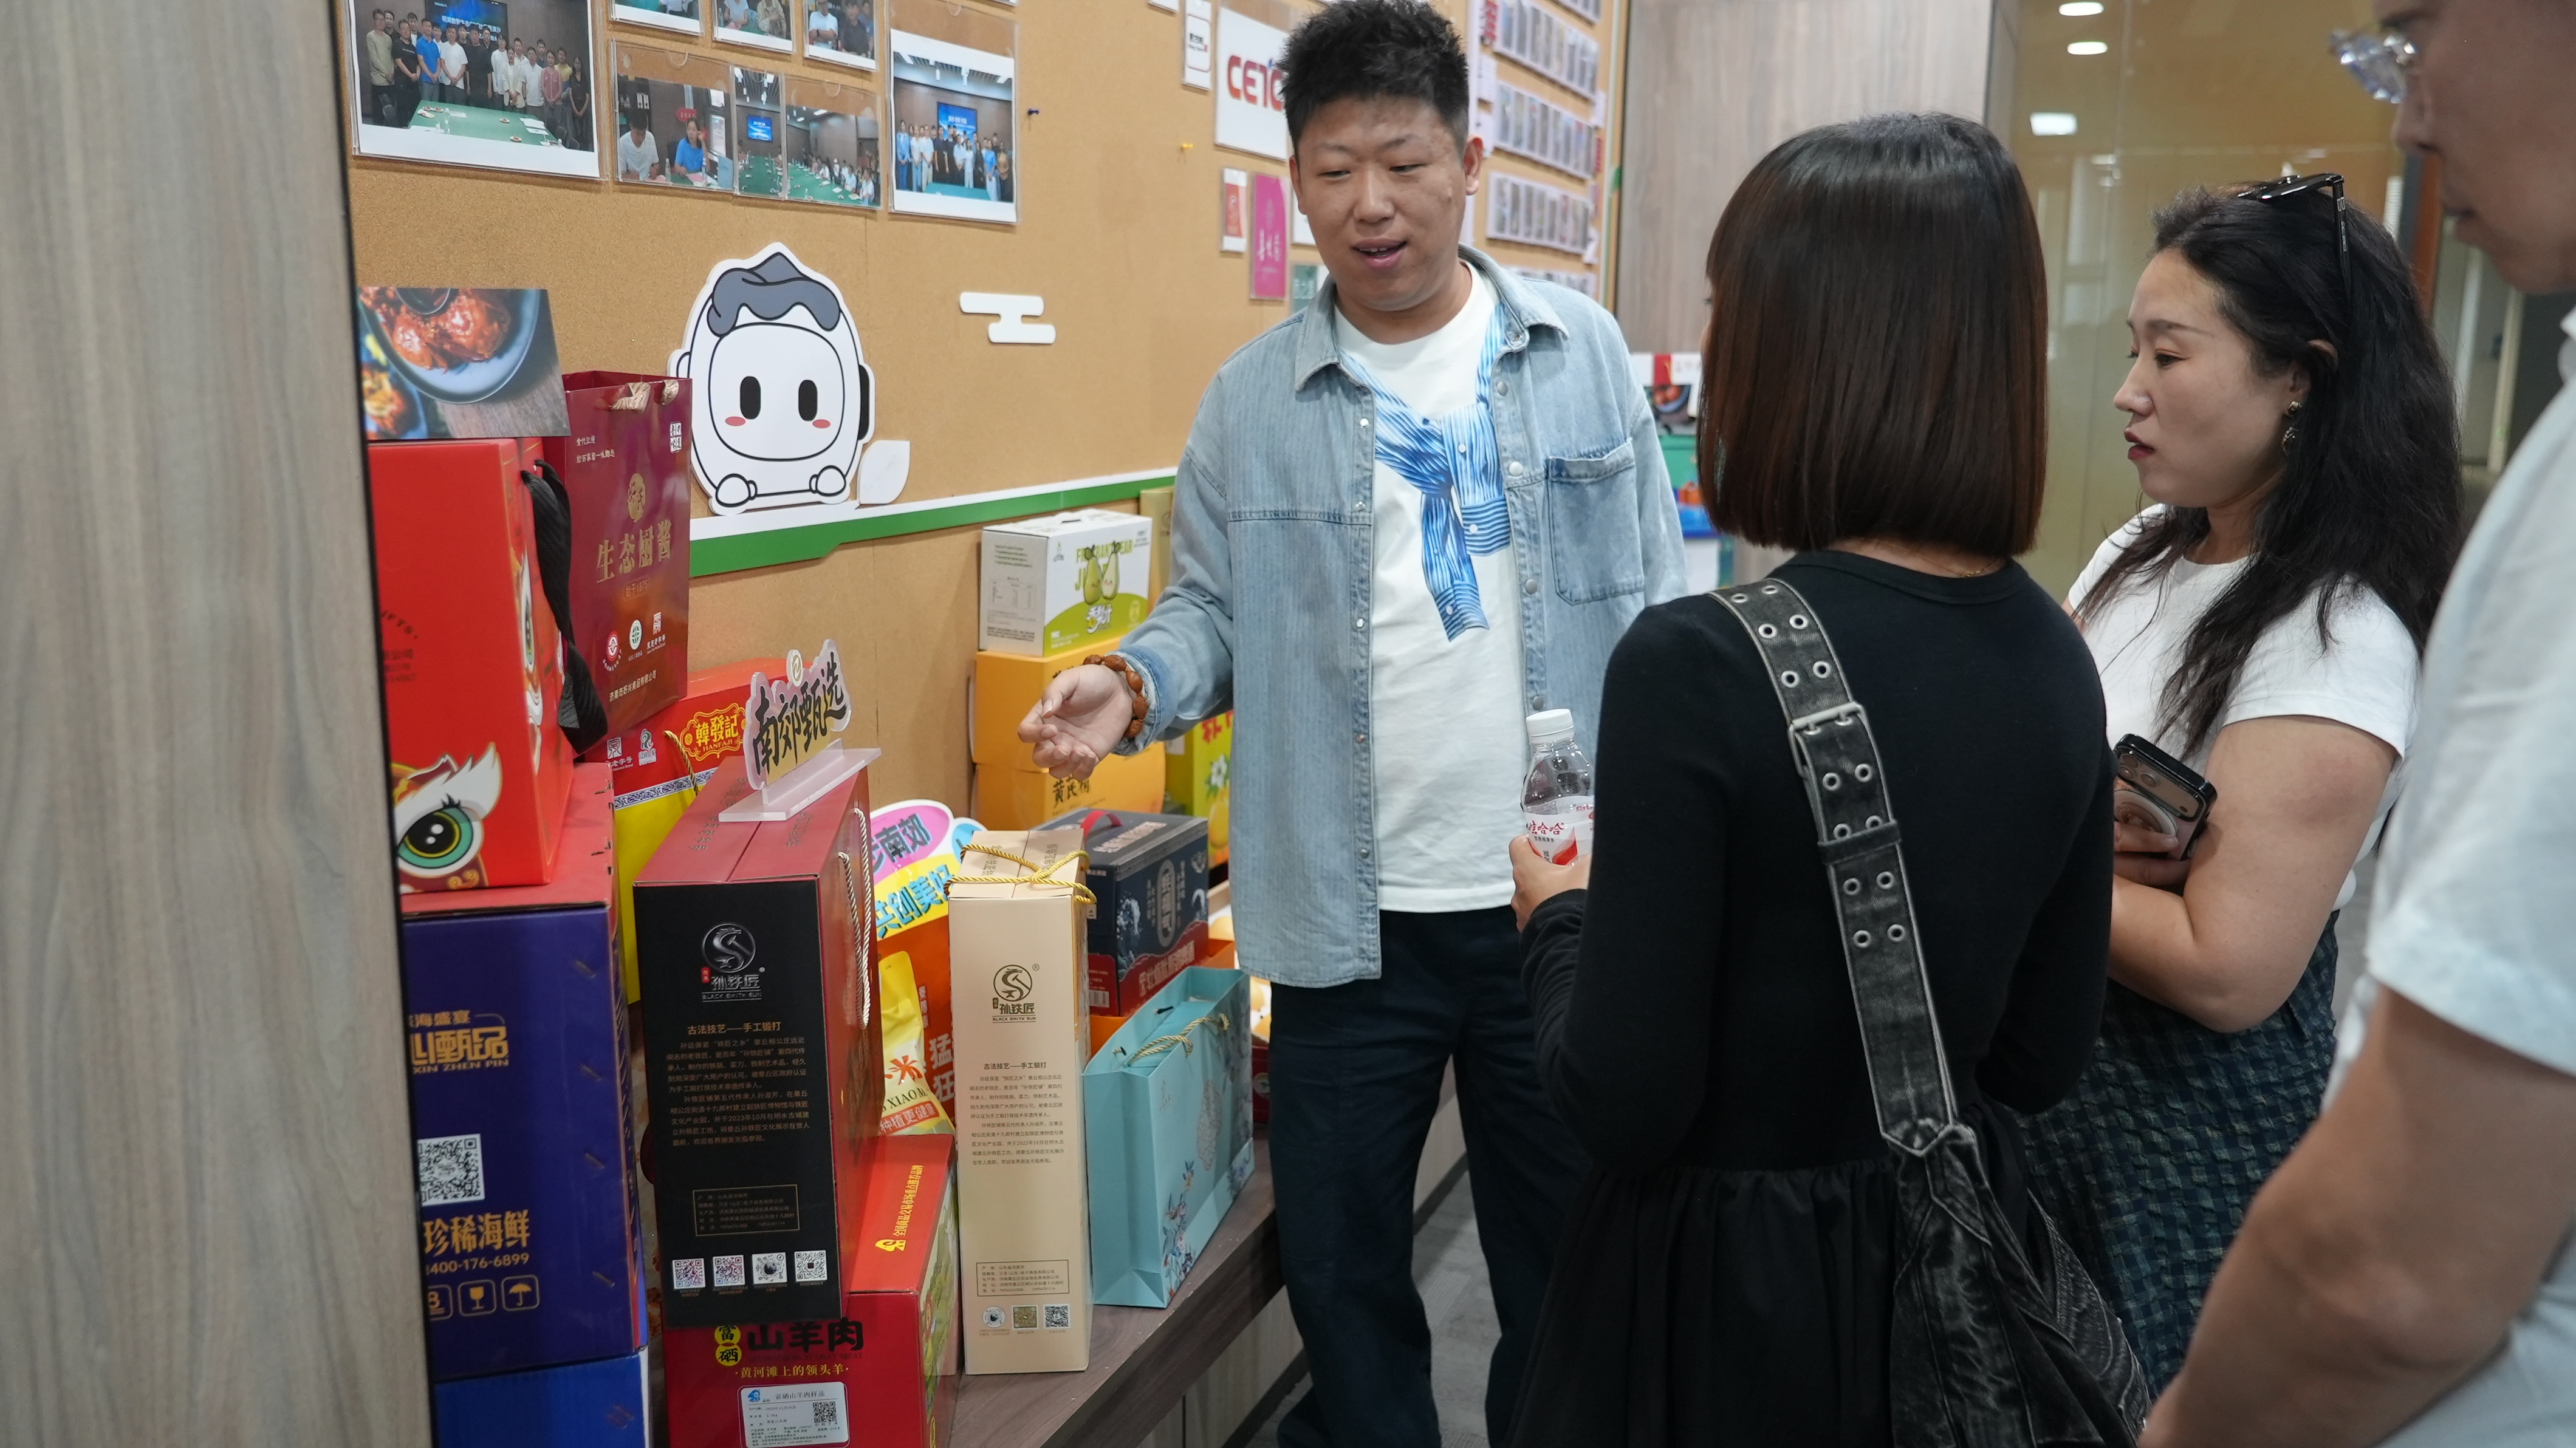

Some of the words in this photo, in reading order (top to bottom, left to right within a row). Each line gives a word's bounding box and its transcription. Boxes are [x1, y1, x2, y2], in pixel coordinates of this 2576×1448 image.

[597, 519, 672, 583] 生态厨酱
[753, 651, 846, 776] 南郊甄选
[695, 714, 739, 747] 韓發記
[1529, 820, 1565, 835] 娃哈哈
[875, 864, 954, 939] 共创美好
[409, 1009, 471, 1028] 海盛宴
[999, 1003, 1035, 1014] 孙铁匠
[886, 1089, 917, 1109] XIAO
[879, 1103, 936, 1135] 种植更健康
[423, 1209, 530, 1257] 珍稀海鲜
[747, 1317, 864, 1353] 山羊肉
